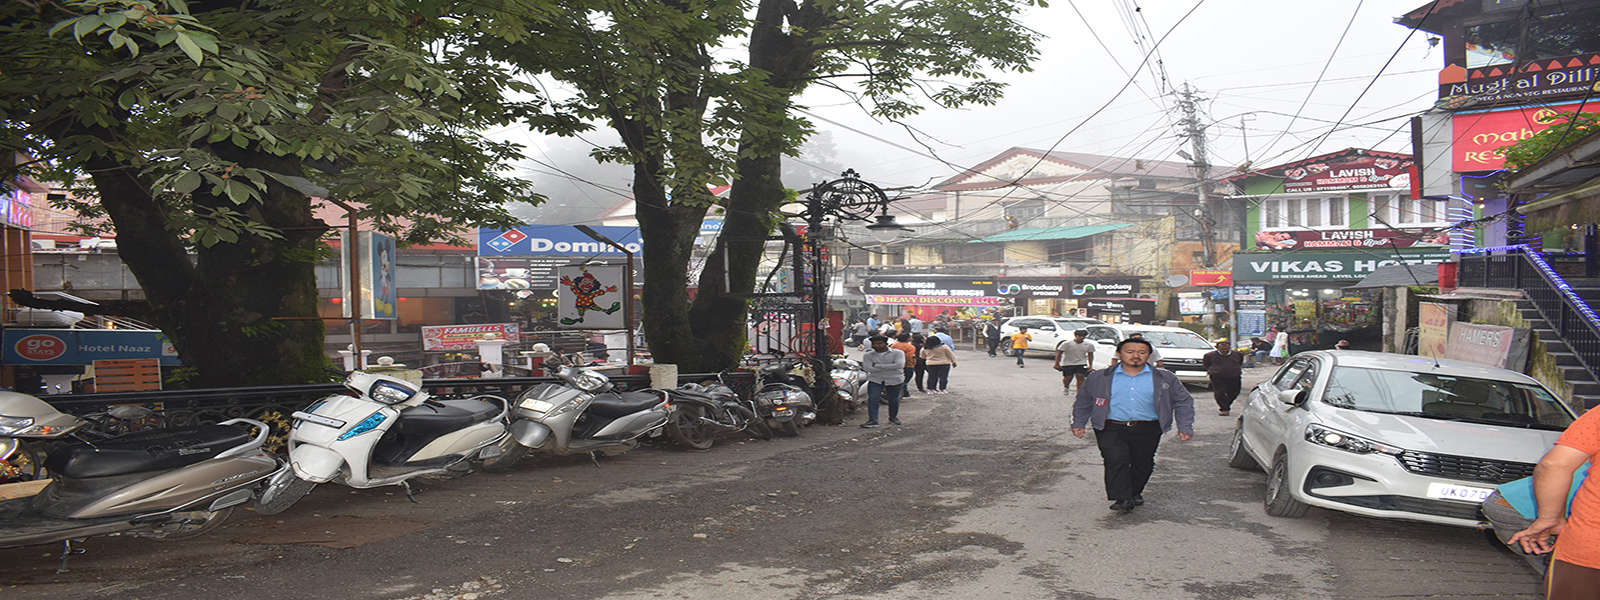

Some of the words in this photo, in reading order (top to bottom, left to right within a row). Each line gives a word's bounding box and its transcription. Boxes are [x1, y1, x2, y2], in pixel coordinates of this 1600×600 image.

[1450, 74, 1539, 96] Mughal
[1330, 168, 1376, 178] LAVISH
[1316, 177, 1358, 185] HAMMAM
[1321, 230, 1374, 240] LAVISH
[1304, 240, 1352, 248] HAMMAM
[1249, 260, 1344, 273] VIKAS
[869, 281, 902, 289] SOBHA
[1022, 283, 1063, 292] Broadway
[1096, 283, 1132, 291] Broadway
[950, 289, 985, 297] SINGH
[886, 296, 917, 304] HEAVY
[918, 297, 973, 305] DISCOUNT
[444, 325, 502, 335] FAMBELLS
[1458, 326, 1501, 348] HAMERS
[26, 339, 56, 350] go
[79, 345, 115, 353] Hotel
[119, 345, 152, 353] Naaz
[1441, 487, 1488, 500] UK07D
